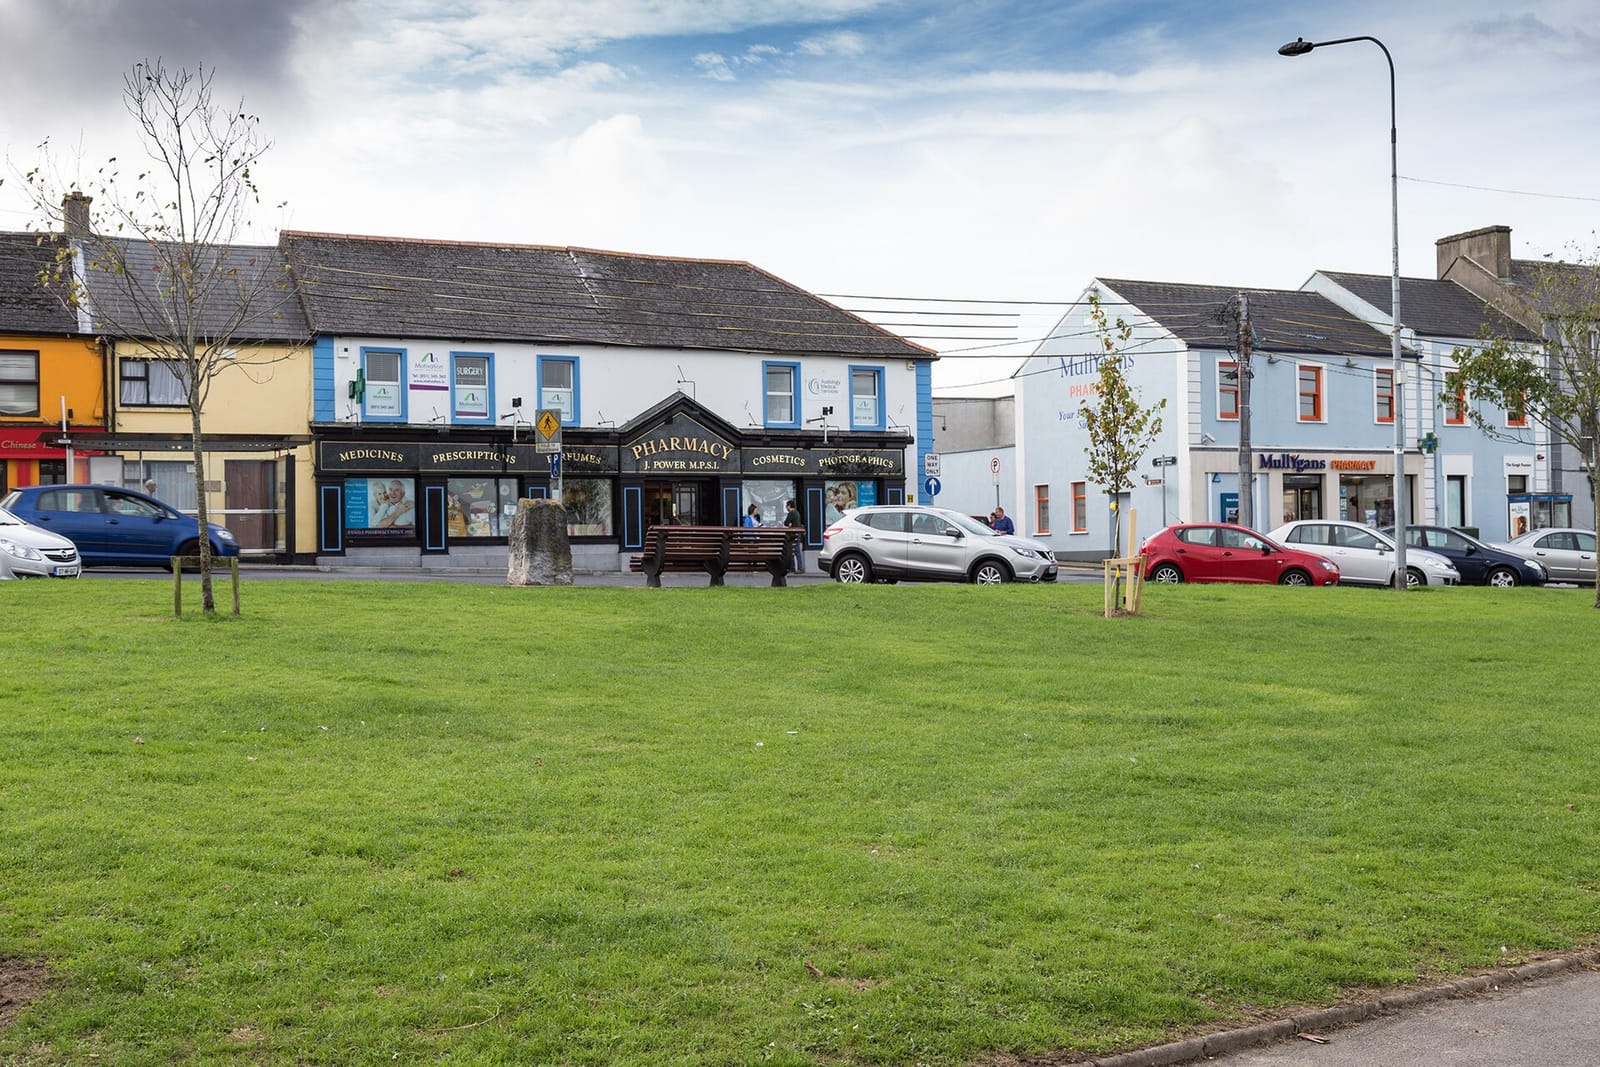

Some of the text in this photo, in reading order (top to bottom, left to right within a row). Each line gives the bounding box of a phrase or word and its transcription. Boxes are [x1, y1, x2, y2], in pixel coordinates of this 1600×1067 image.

[456, 367, 484, 376] SURGERY
[1059, 411, 1074, 421] Your
[1, 440, 37, 449] Chinese
[632, 436, 733, 460] PHARMACY
[339, 449, 404, 462] MEDICINES
[432, 450, 517, 464] PRESCRIPTIONS
[546, 452, 602, 465] PRFUMES
[553, 455, 559, 464] P
[752, 454, 806, 467] COSMETICS
[644, 461, 720, 470] J. POWER M.P.S.I.
[818, 455, 895, 469] PHOTOGRAPHICS
[1330, 460, 1377, 470] PHARMACY
